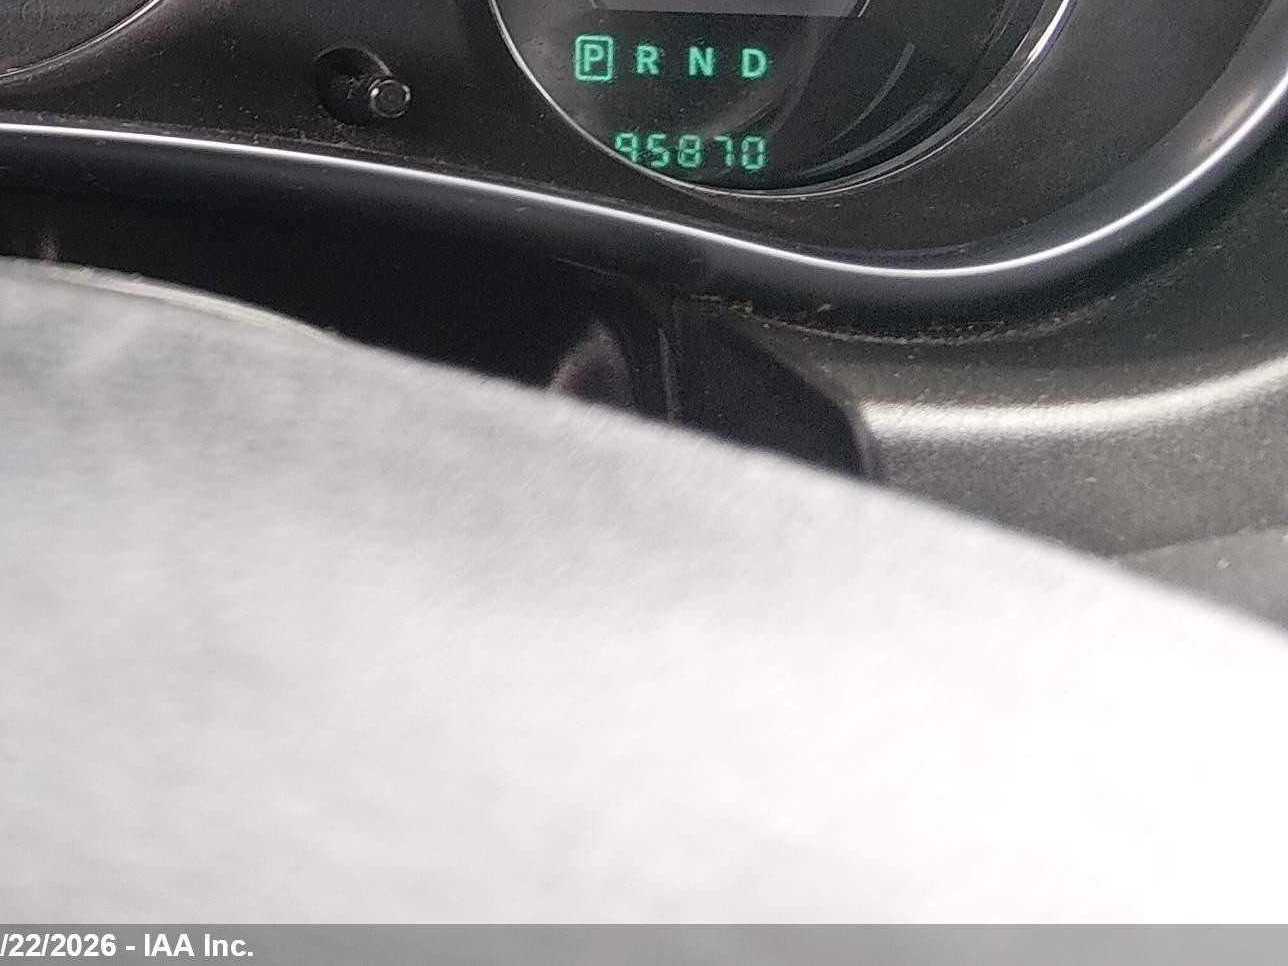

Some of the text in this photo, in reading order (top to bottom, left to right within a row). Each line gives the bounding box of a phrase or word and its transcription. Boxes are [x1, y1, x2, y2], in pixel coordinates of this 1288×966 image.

[583, 44, 766, 77] P R N D
[615, 133, 765, 170] 95870
